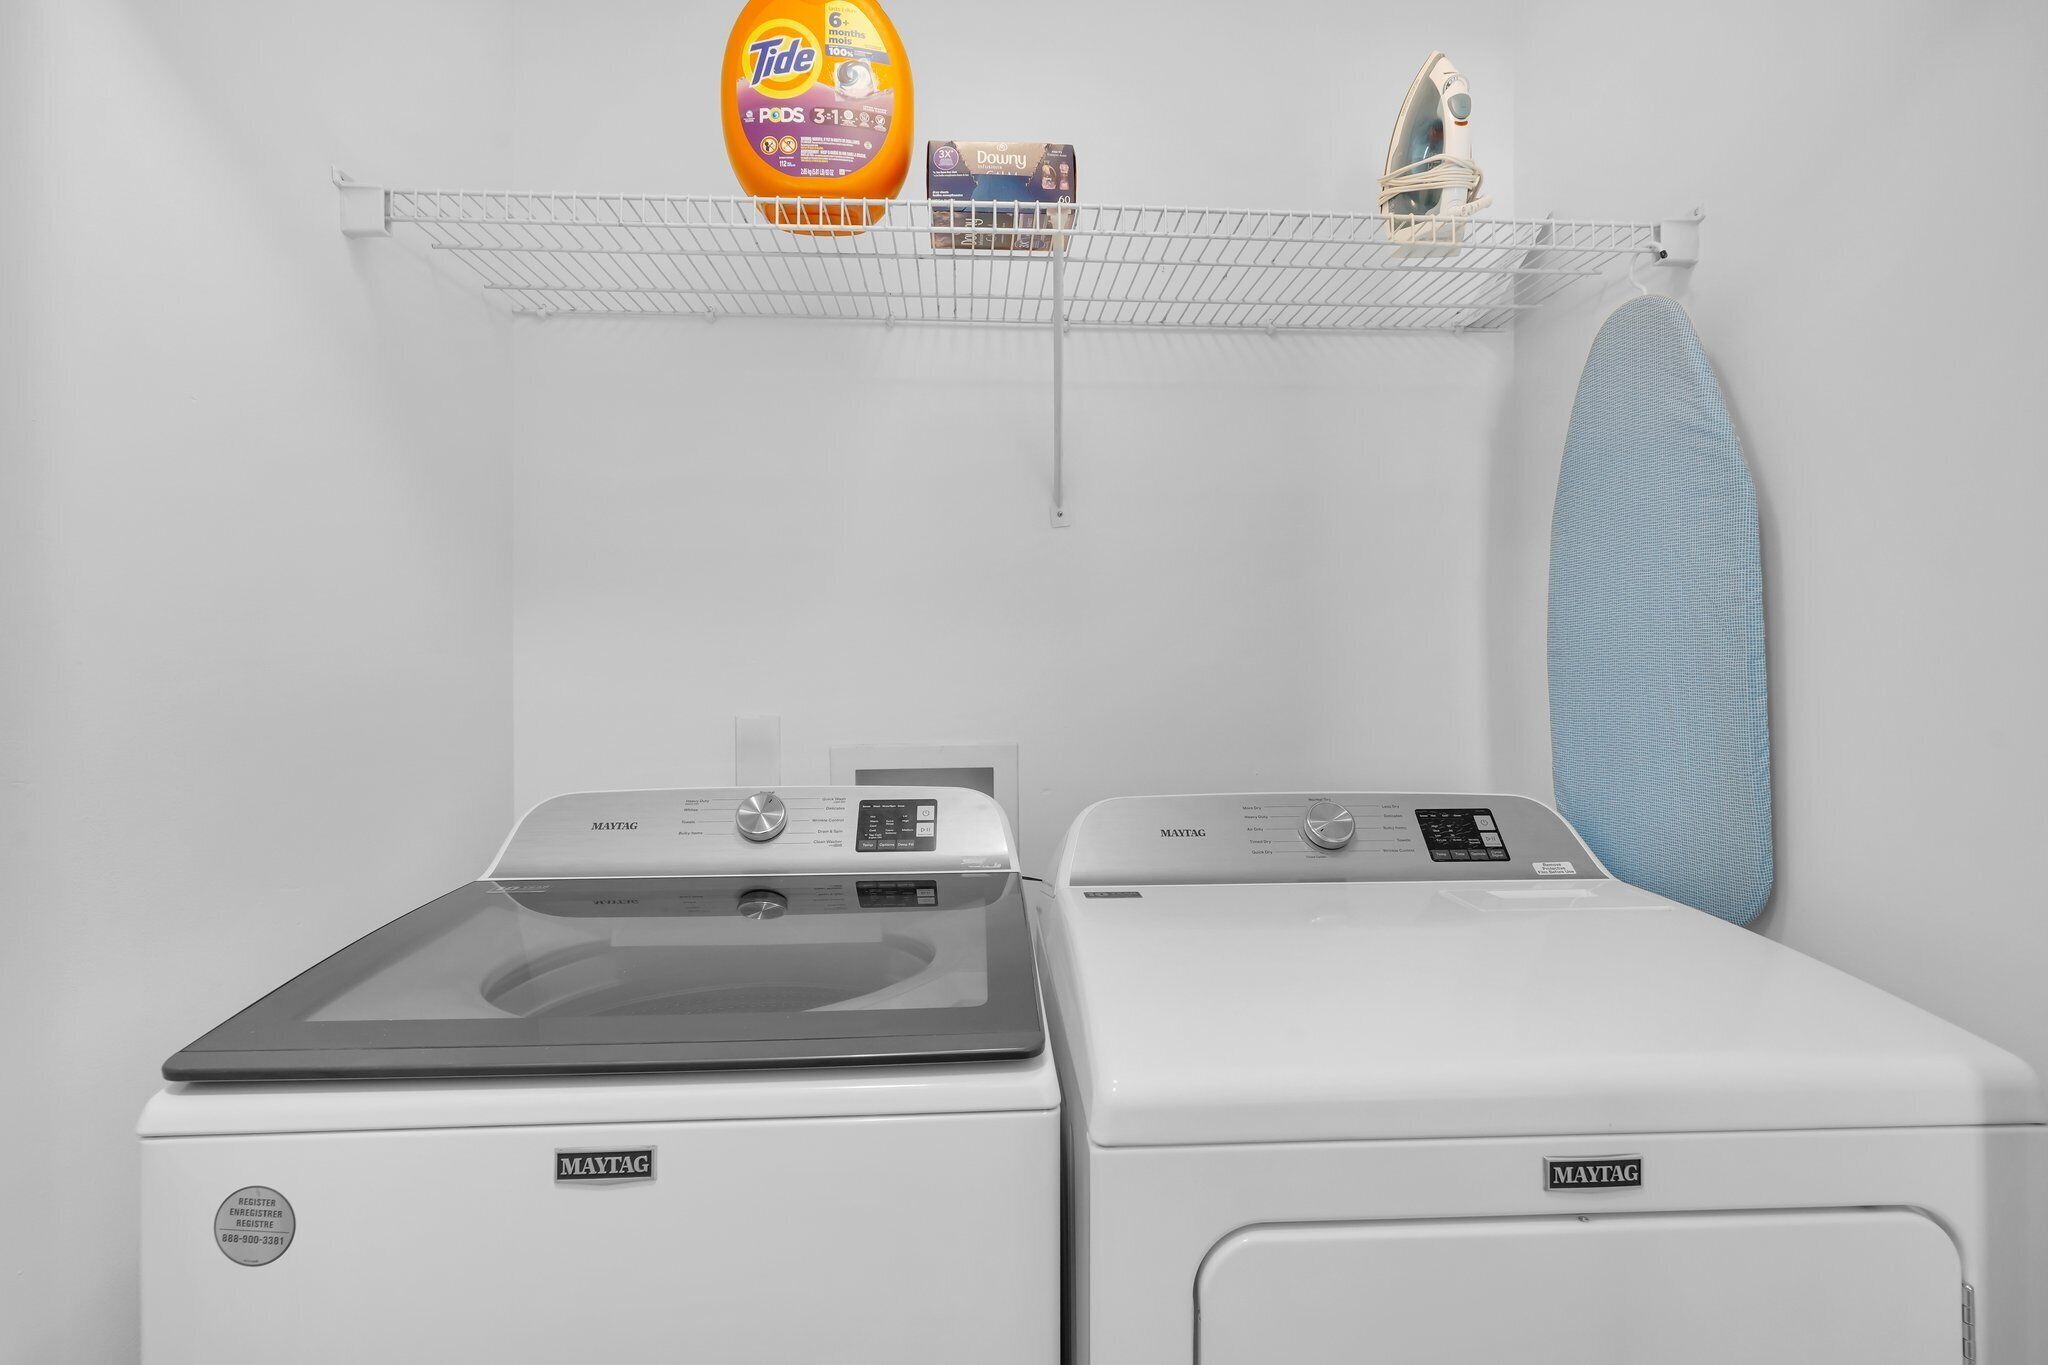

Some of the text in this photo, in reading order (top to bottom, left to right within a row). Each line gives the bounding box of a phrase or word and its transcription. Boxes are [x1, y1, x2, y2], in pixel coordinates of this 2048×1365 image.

[829, 12, 849, 28] 6+
[829, 29, 866, 39] months
[829, 37, 853, 45] mois
[829, 47, 854, 57] 100%
[749, 37, 816, 87] Tide
[759, 107, 804, 123] PODS
[977, 151, 1027, 169] Downy
[1058, 195, 1071, 203] 60
[961, 218, 983, 246] Dony
[591, 822, 638, 830] MAYTAG
[1160, 829, 1206, 837] MAYTAG
[561, 1155, 649, 1175] MAYTAG
[1553, 1165, 1638, 1183] MAYTAG
[238, 1197, 276, 1206] REGISTER
[229, 1208, 282, 1218] ENREGISTRER
[236, 1219, 274, 1228] REGISTRE
[222, 1233, 284, 1245] 888-900-3381
